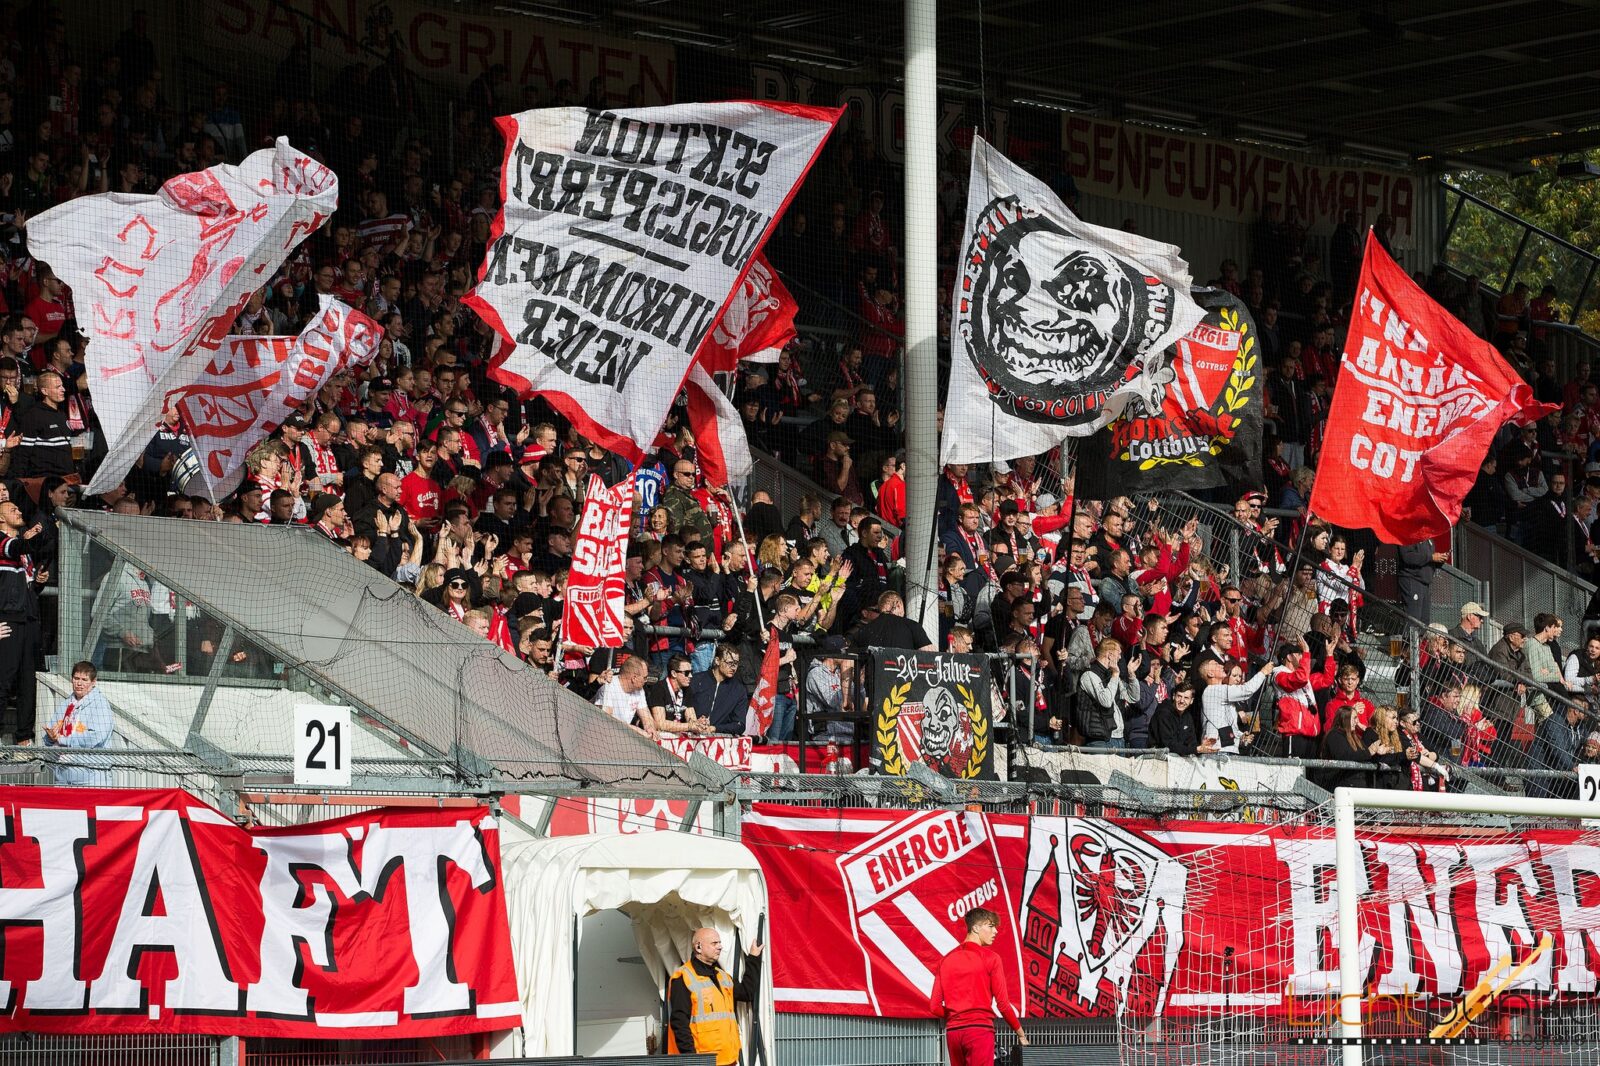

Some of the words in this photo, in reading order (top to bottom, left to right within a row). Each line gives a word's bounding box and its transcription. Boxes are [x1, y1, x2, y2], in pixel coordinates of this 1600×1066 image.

[1188, 325, 1230, 346] ERGIE
[1195, 360, 1229, 371] COTTBUS
[1129, 434, 1212, 462] Cottbus
[635, 478, 657, 507] 10
[896, 654, 918, 681] 20
[925, 655, 971, 687] Jahre
[304, 719, 342, 770] 21
[1584, 775, 1600, 801] 2
[867, 811, 971, 895] ENERGIE
[946, 877, 998, 923] COTTBUS
